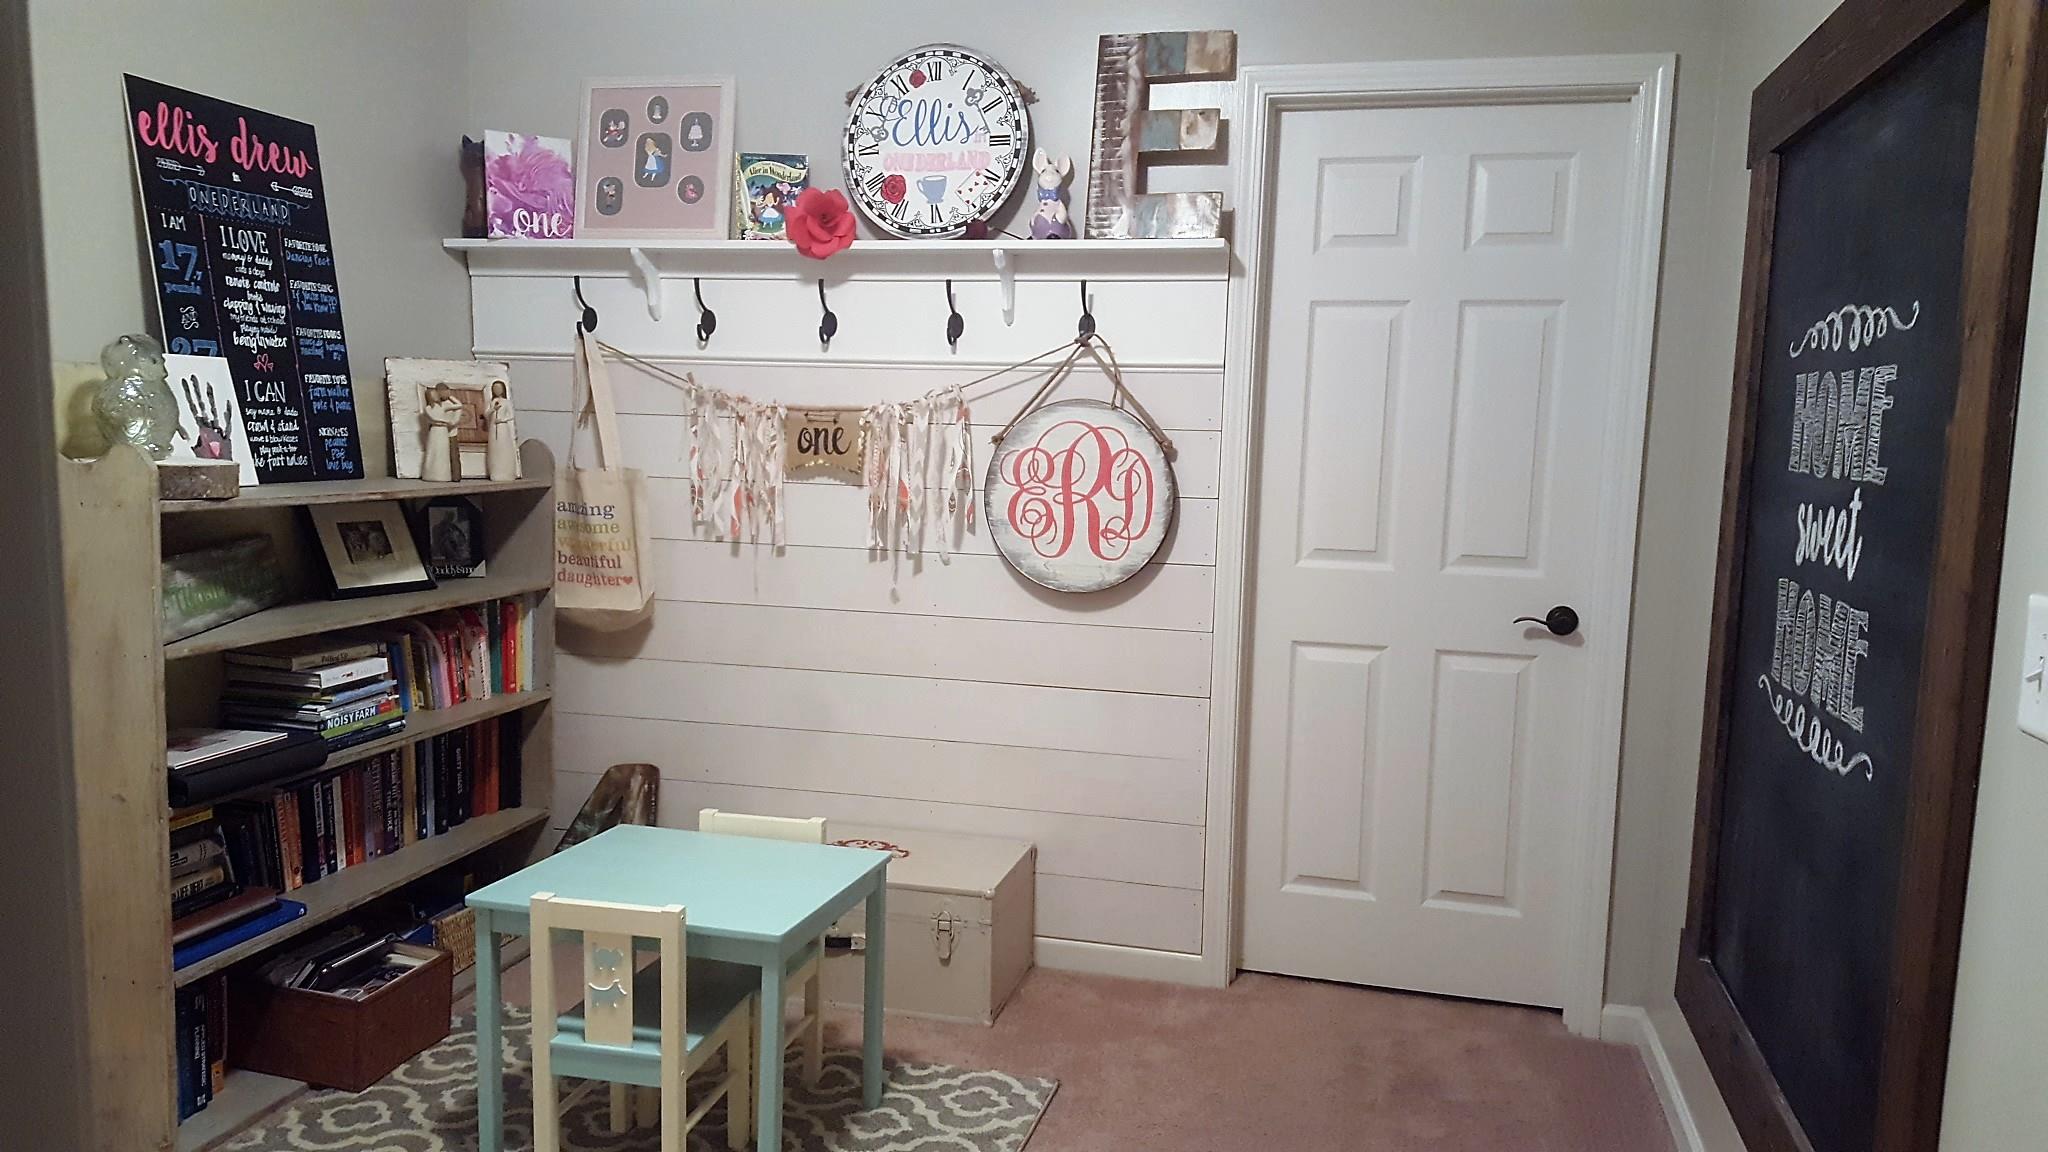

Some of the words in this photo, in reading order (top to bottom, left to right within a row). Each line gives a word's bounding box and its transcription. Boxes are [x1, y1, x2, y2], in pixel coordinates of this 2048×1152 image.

[927, 61, 942, 82] XII
[892, 99, 979, 147] Ellis
[138, 101, 219, 163] ellis
[231, 117, 313, 178] drew
[769, 166, 802, 182] Wonderland
[189, 187, 288, 219] ONEDERLAND
[160, 213, 167, 228] I
[169, 216, 187, 231] AM
[513, 208, 572, 238] one
[219, 225, 228, 247] I
[228, 227, 269, 254] LOVE
[225, 276, 250, 289] remote
[253, 280, 280, 292] controls
[224, 297, 253, 315] clapping
[233, 331, 257, 354] being
[245, 380, 252, 402] I
[254, 381, 286, 403] CAN
[1789, 363, 1898, 486] HOME
[797, 427, 852, 456] one
[267, 453, 285, 471] fart
[1795, 486, 1863, 582] sweet
[557, 568, 622, 588] daughter
[1771, 578, 1869, 734] HOME
[326, 712, 354, 730] NOISY
[355, 705, 376, 722] FARM
